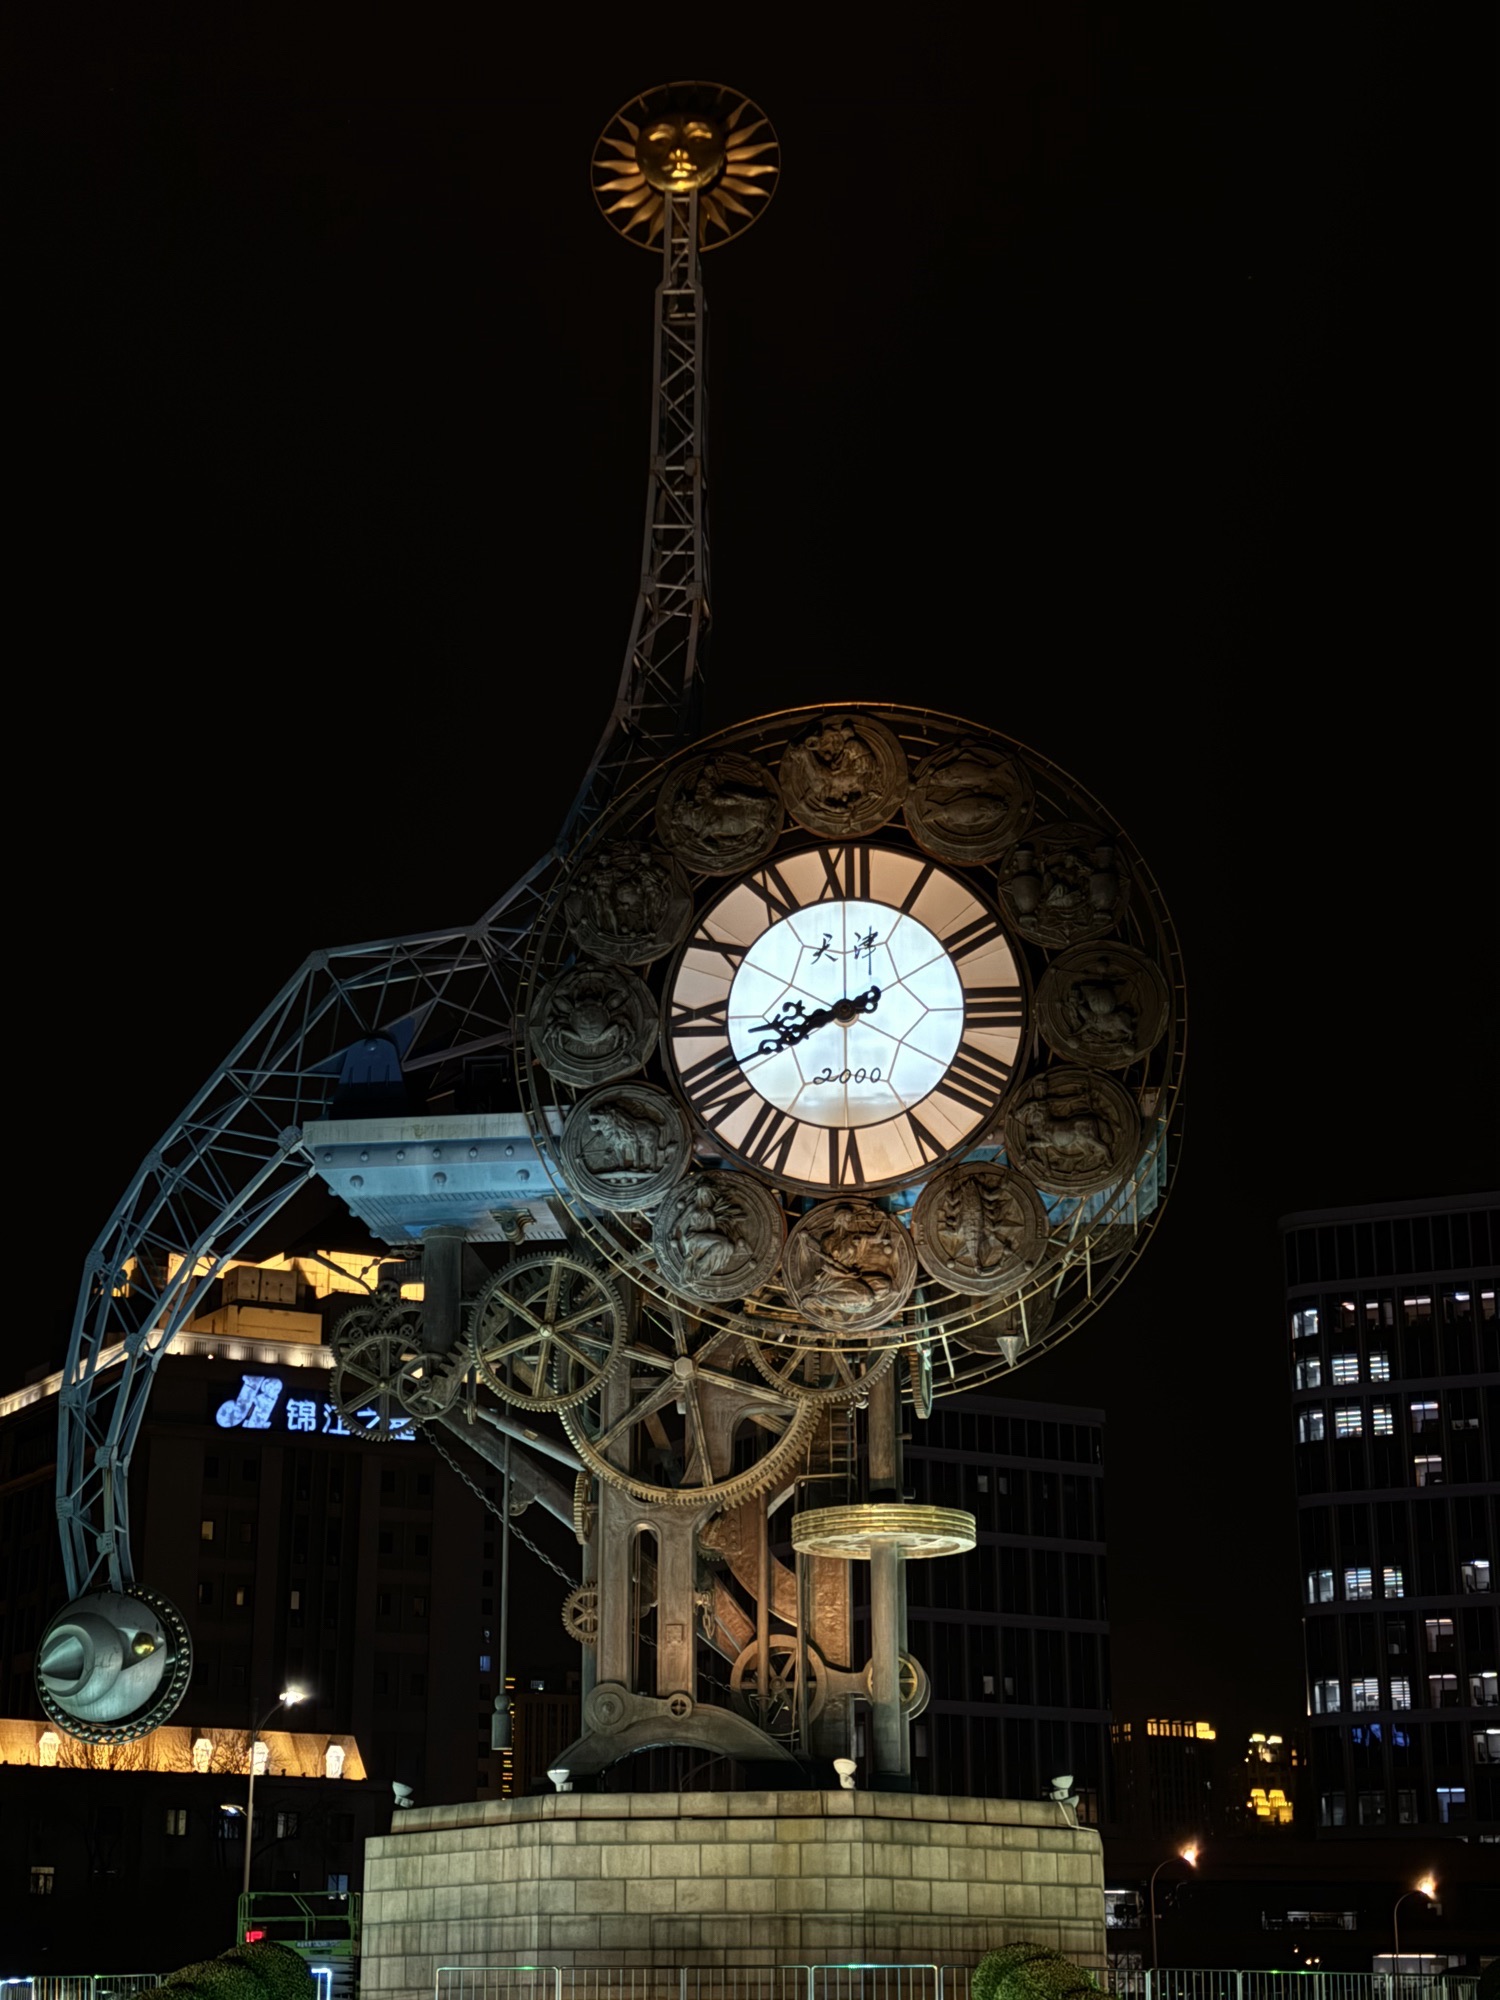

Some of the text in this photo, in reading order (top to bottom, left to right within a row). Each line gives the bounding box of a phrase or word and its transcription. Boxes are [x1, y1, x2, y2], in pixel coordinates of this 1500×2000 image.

[738, 863, 802, 927] XI
[818, 848, 870, 901] XII
[901, 861, 935, 914] I
[687, 922, 750, 972] X
[810, 925, 879, 976] 天津
[940, 911, 1002, 962] II
[671, 1001, 728, 1038] IX
[963, 986, 1023, 1029] III
[678, 1045, 757, 1129] VIII
[812, 1067, 882, 1085] 2000
[738, 1101, 799, 1177] VII
[827, 1127, 867, 1188] VI
[906, 1109, 949, 1166] V
